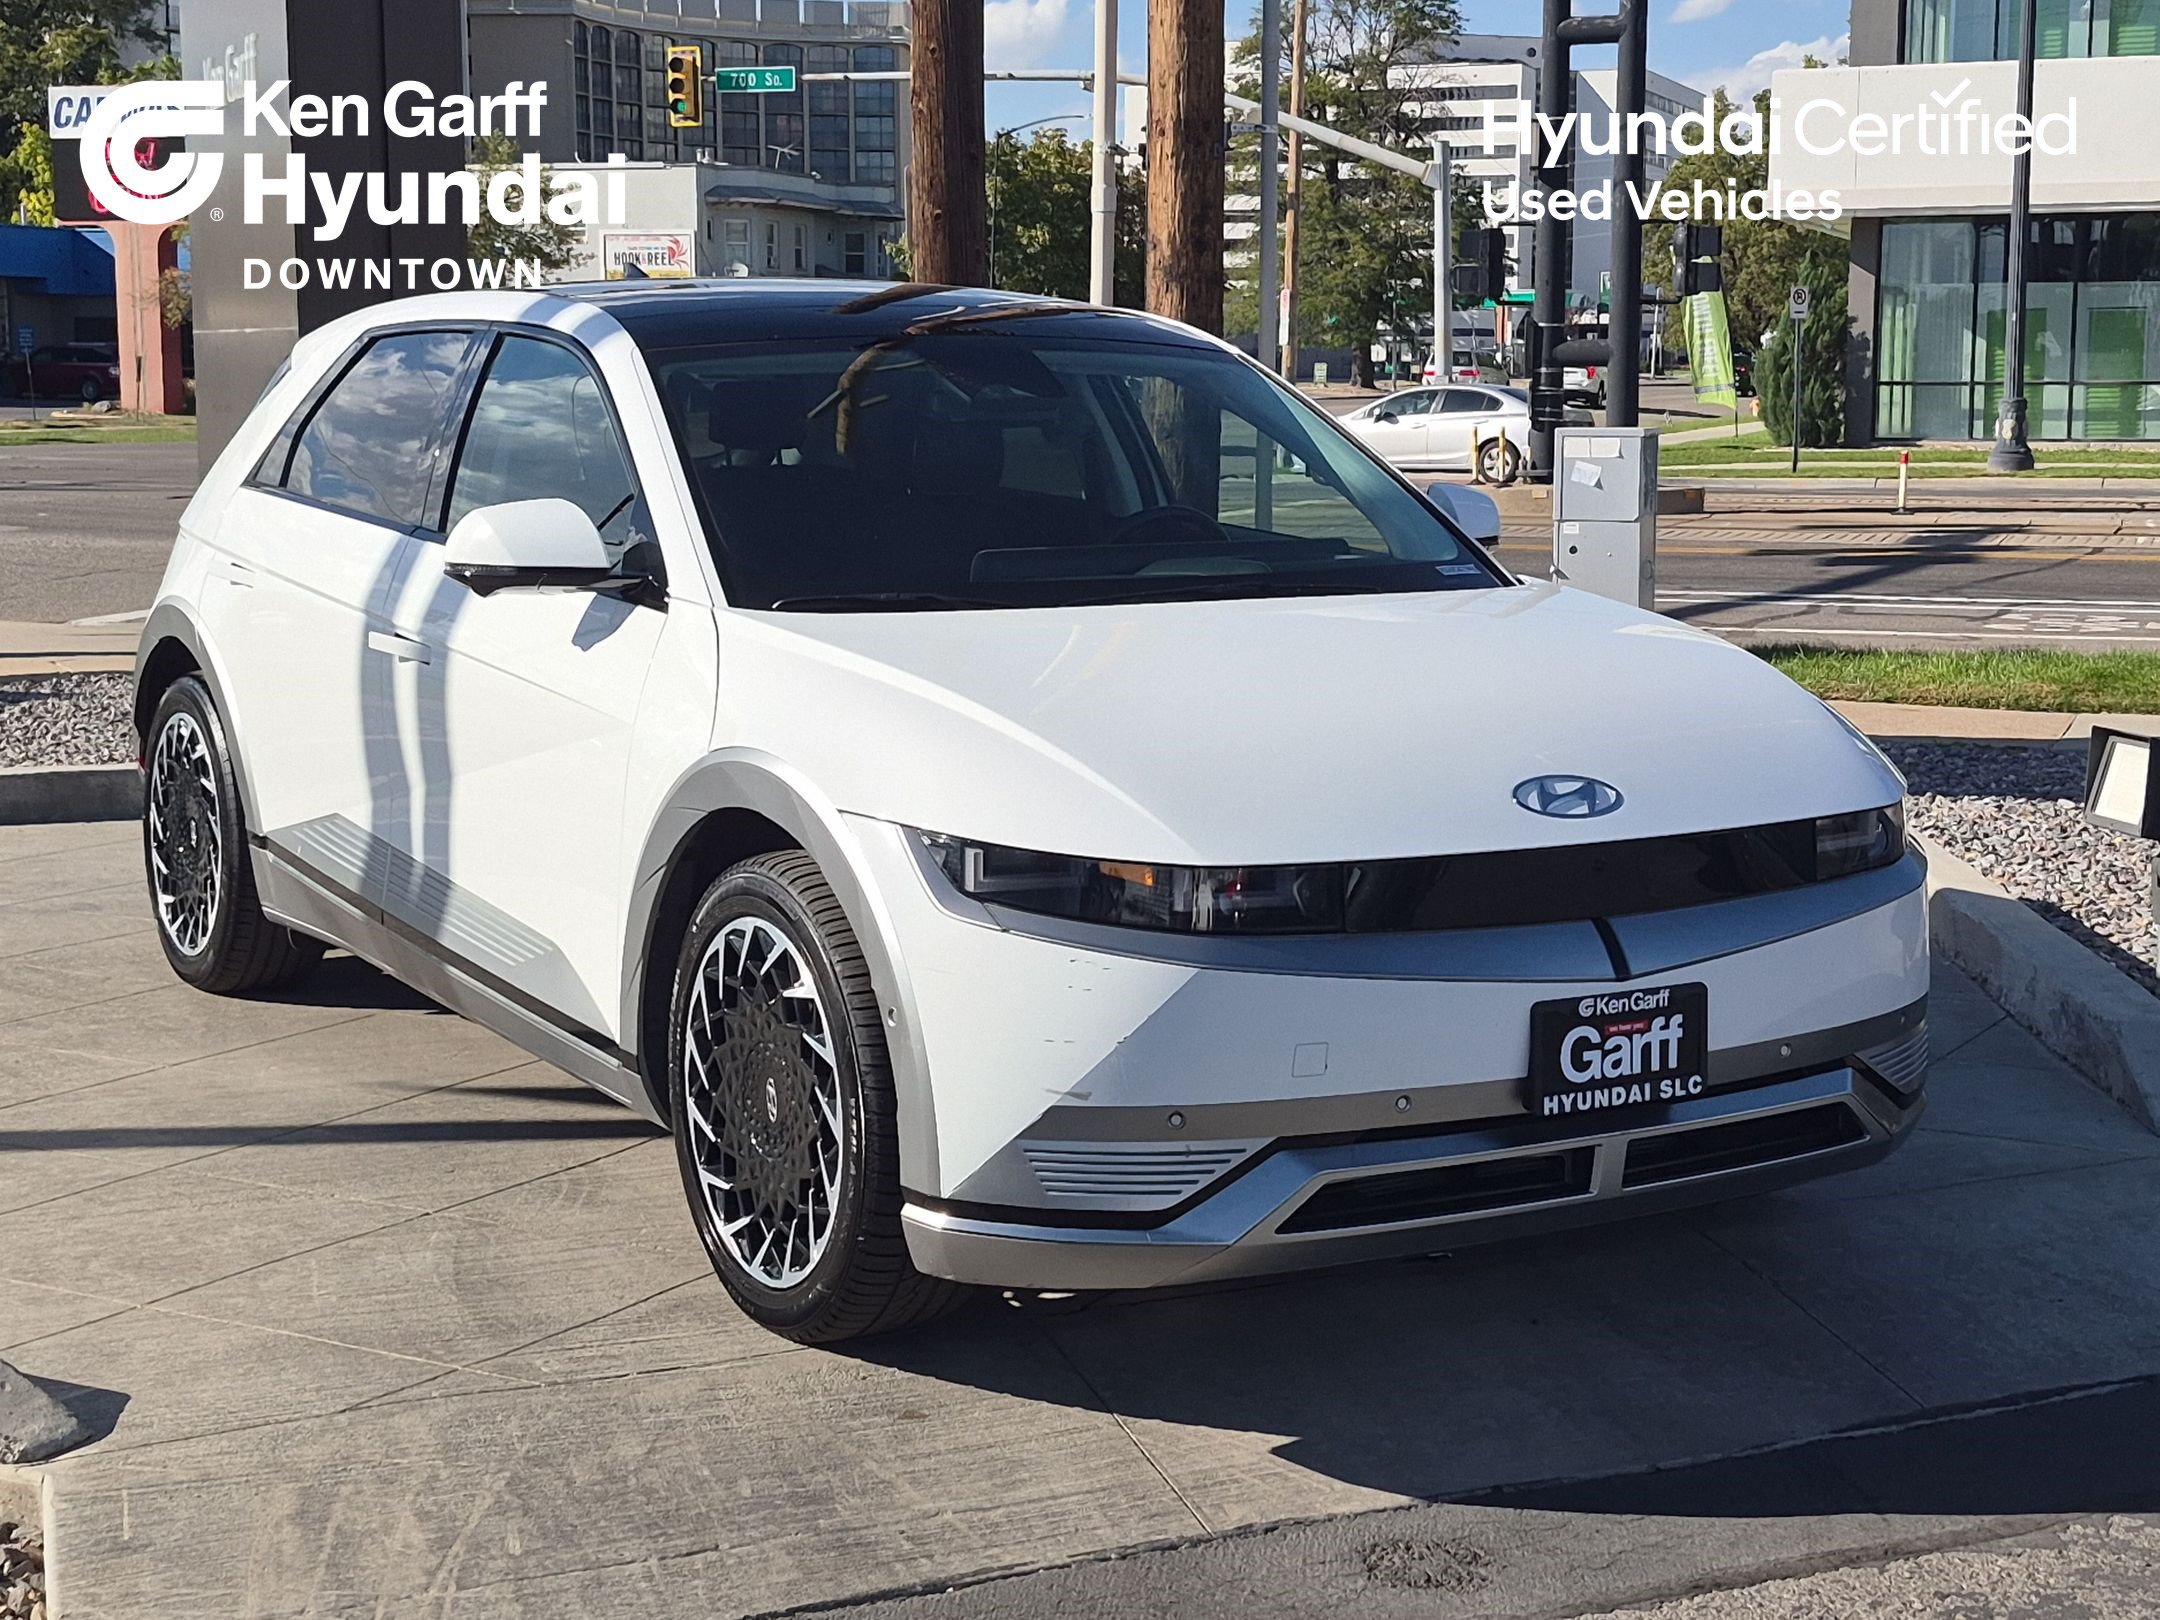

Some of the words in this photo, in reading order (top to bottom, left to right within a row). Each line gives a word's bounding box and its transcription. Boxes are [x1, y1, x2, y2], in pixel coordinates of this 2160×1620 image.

[730, 72, 757, 87] 700
[764, 72, 783, 86] So.
[1596, 997, 1629, 1016] Ken
[1630, 989, 1670, 1011] Garff
[1560, 1014, 1684, 1084] Garff
[1543, 1082, 1651, 1116] HYUNDAI
[1659, 1074, 1703, 1099] SLC
